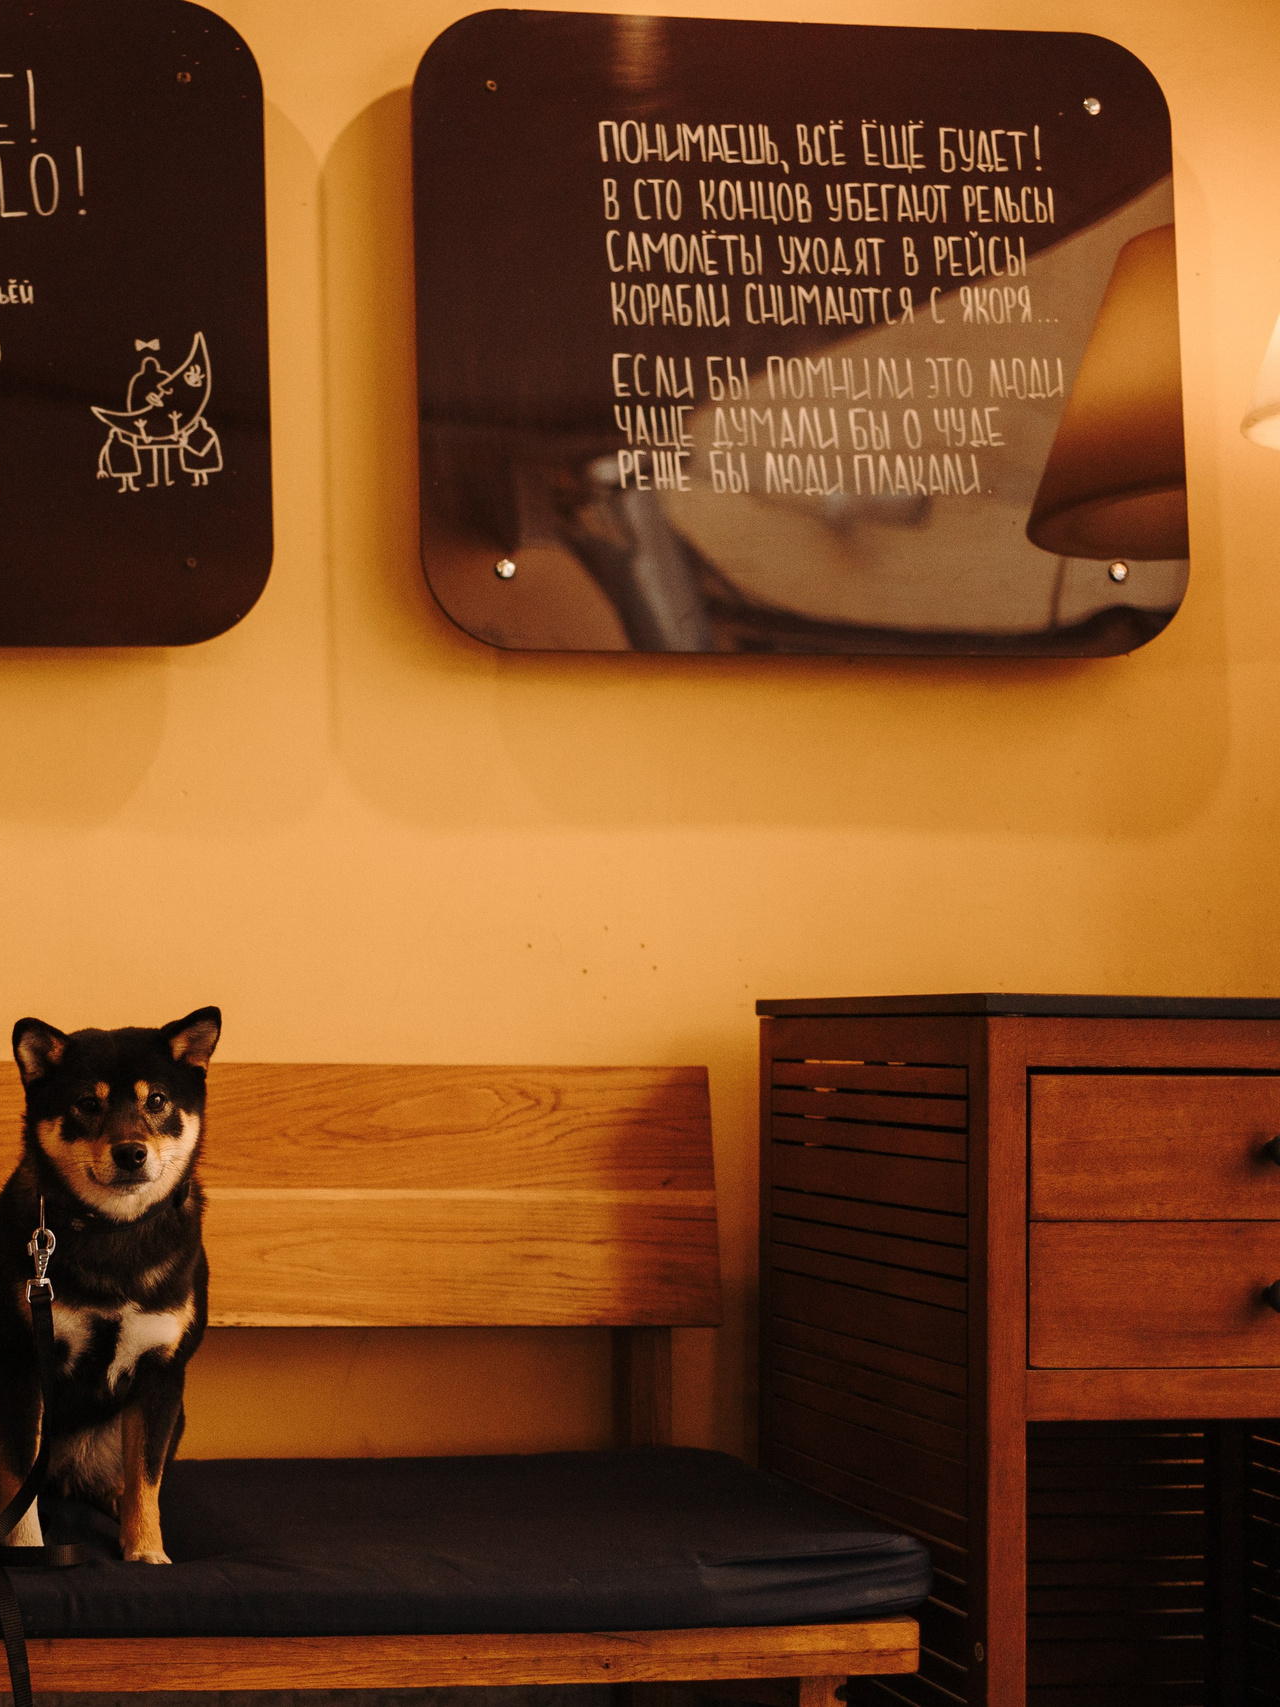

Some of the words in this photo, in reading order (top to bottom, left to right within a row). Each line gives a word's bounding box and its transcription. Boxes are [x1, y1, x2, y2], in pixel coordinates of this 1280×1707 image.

[597, 119, 790, 175] ПОНИМАЕШЬ,
[795, 119, 847, 167] ВСЁ
[938, 123, 1043, 174] БУДЕТ!
[602, 177, 621, 221] В
[633, 178, 683, 222] СТО
[698, 178, 813, 226] КОНЦОВ
[824, 181, 952, 224] УБЕГАЮТ
[961, 184, 1055, 224] РЕЛЬСЫ
[605, 228, 763, 277] САМОЛЁТЫ
[777, 234, 886, 277] УХОДЯТ
[902, 235, 920, 277] В
[932, 230, 1026, 277] РЕЙСЫ
[609, 280, 731, 328] КОРАБЛИ
[744, 281, 914, 327] СНИМАЮТСЯ
[929, 285, 944, 324] С
[611, 351, 695, 399] ЕСЛИ
[705, 355, 750, 402] БЫ
[765, 354, 914, 401] ПОМНИЛИ
[924, 356, 973, 399] ЭТО
[989, 357, 1064, 400] ЛЮДИ
[612, 403, 695, 451] ЧАЩЕ
[712, 406, 840, 452] ДУМАЛИ
[848, 407, 891, 451] БЫ
[902, 408, 922, 450] О
[933, 406, 1006, 448] ЧУДЕ
[617, 447, 692, 492] РЕЖЕ
[708, 449, 750, 494] БЫ
[765, 451, 844, 497] ЛЮДИ
[853, 453, 992, 497] ПЛАКАЛИ.
